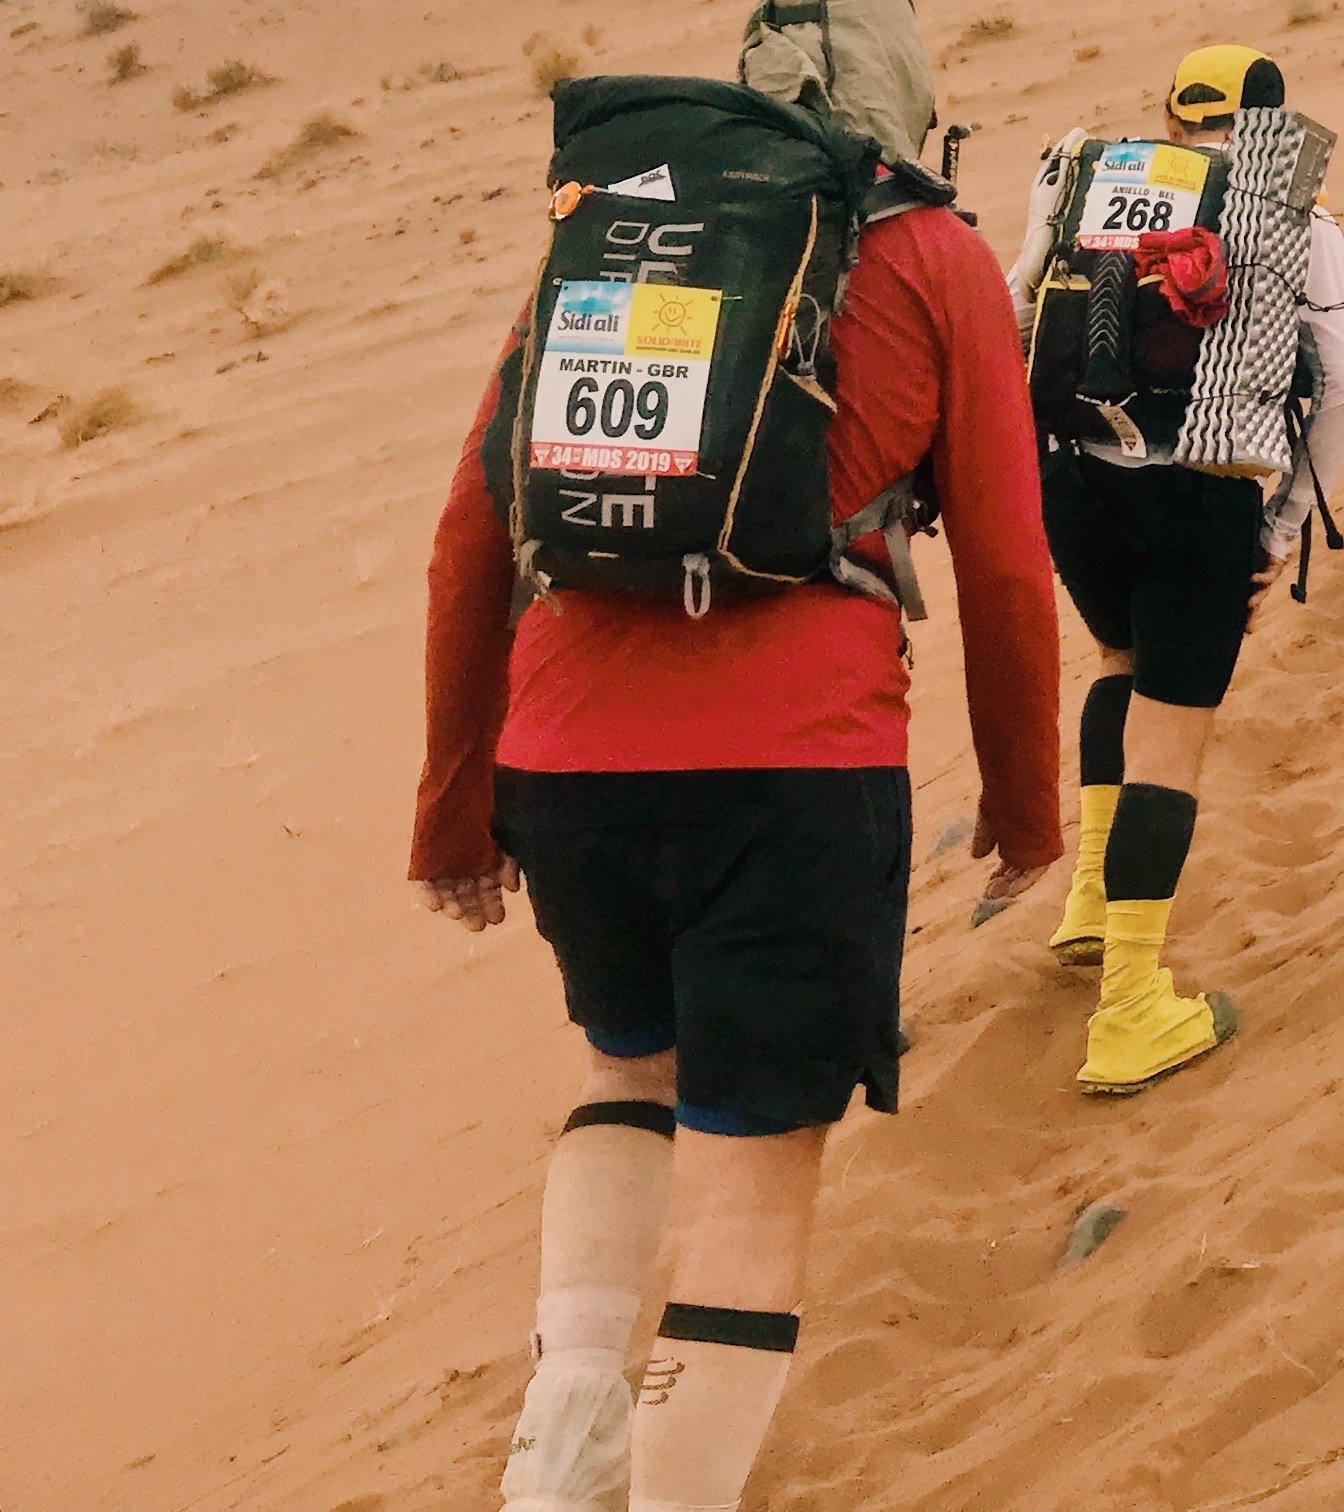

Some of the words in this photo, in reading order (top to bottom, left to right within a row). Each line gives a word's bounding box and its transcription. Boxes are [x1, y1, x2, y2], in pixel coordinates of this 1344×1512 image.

[1112, 185, 1150, 197] ANIELLO
[1158, 190, 1175, 201] BEL
[1102, 196, 1173, 232] 268
[557, 310, 592, 332] Sidi
[594, 315, 619, 333] ali
[559, 358, 632, 375] MARTIN
[647, 363, 689, 379] GBR
[566, 377, 669, 440] 609
[582, 447, 623, 470] MDS
[625, 452, 671, 473] 2019
